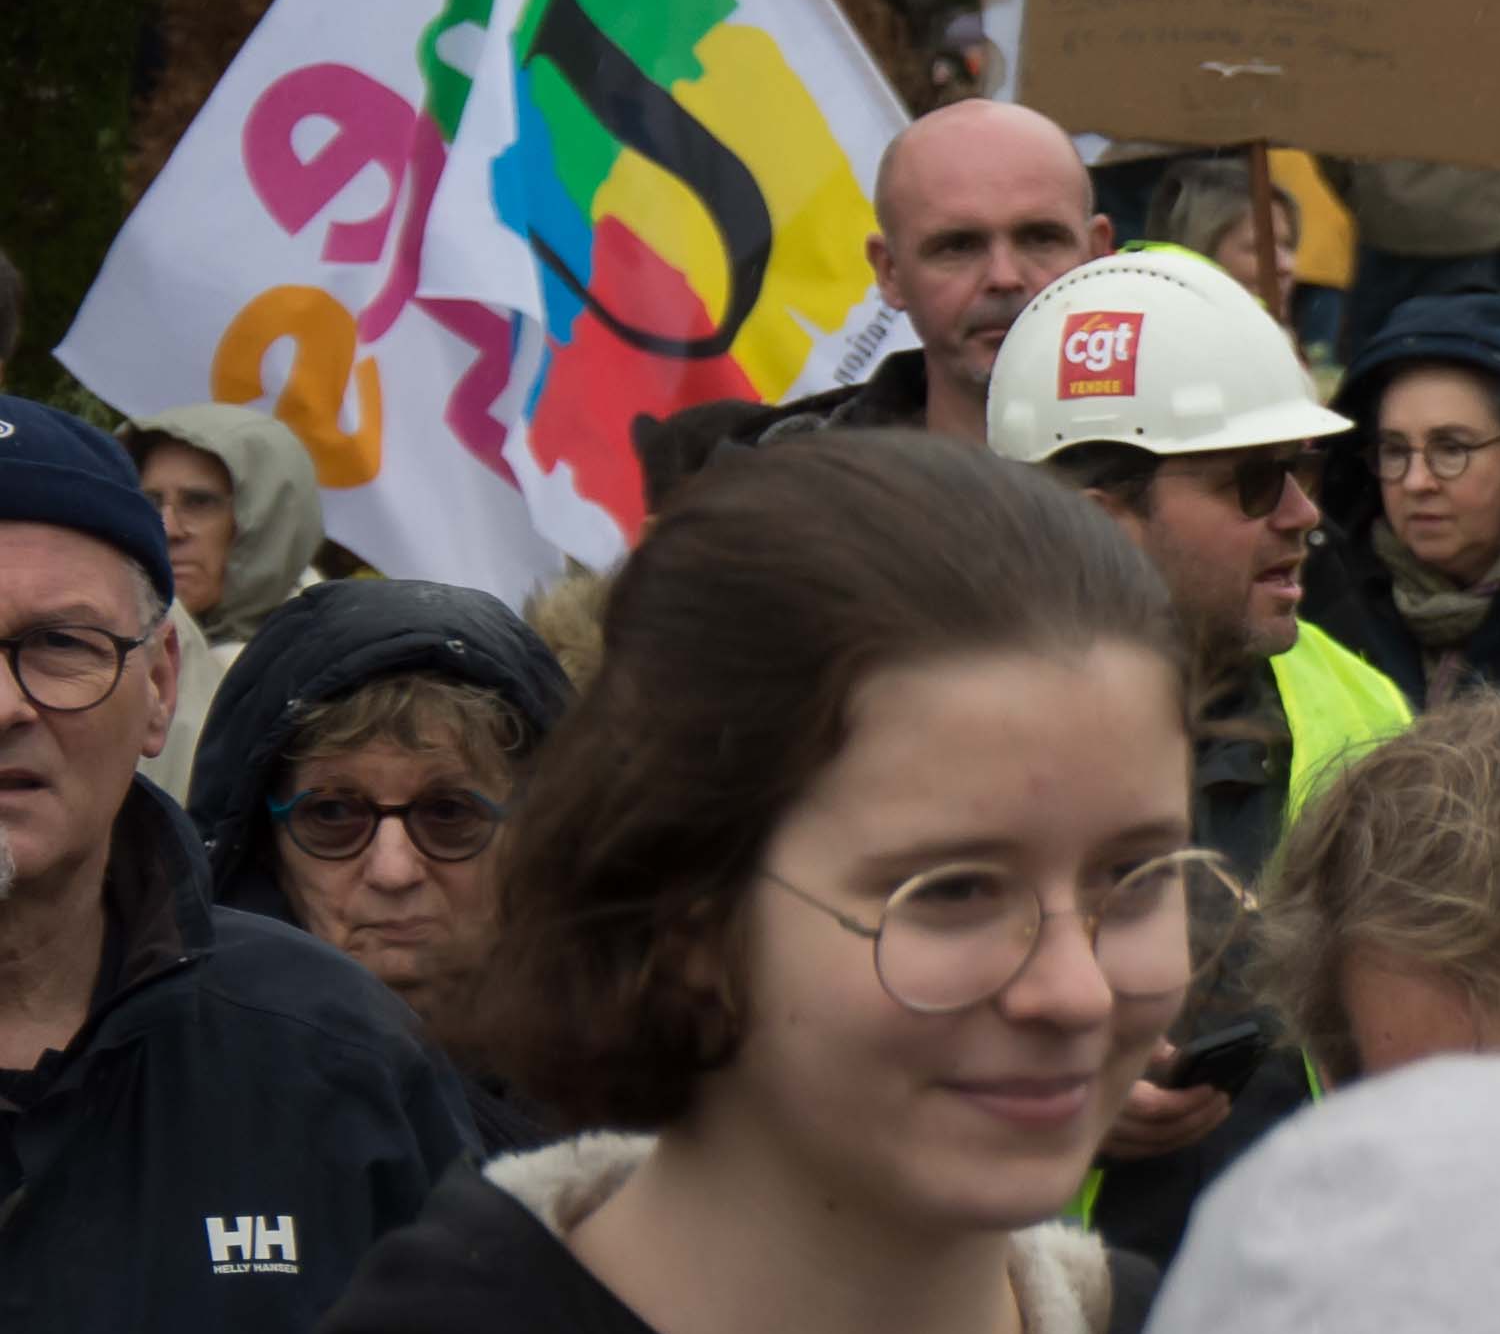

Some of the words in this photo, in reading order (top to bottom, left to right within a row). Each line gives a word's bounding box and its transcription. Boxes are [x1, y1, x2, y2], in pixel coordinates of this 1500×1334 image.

[1065, 322, 1133, 372] cgt
[205, 1215, 297, 1261] HH
[213, 1264, 250, 1274] HELLY
[253, 1263, 298, 1274] HANSEN
